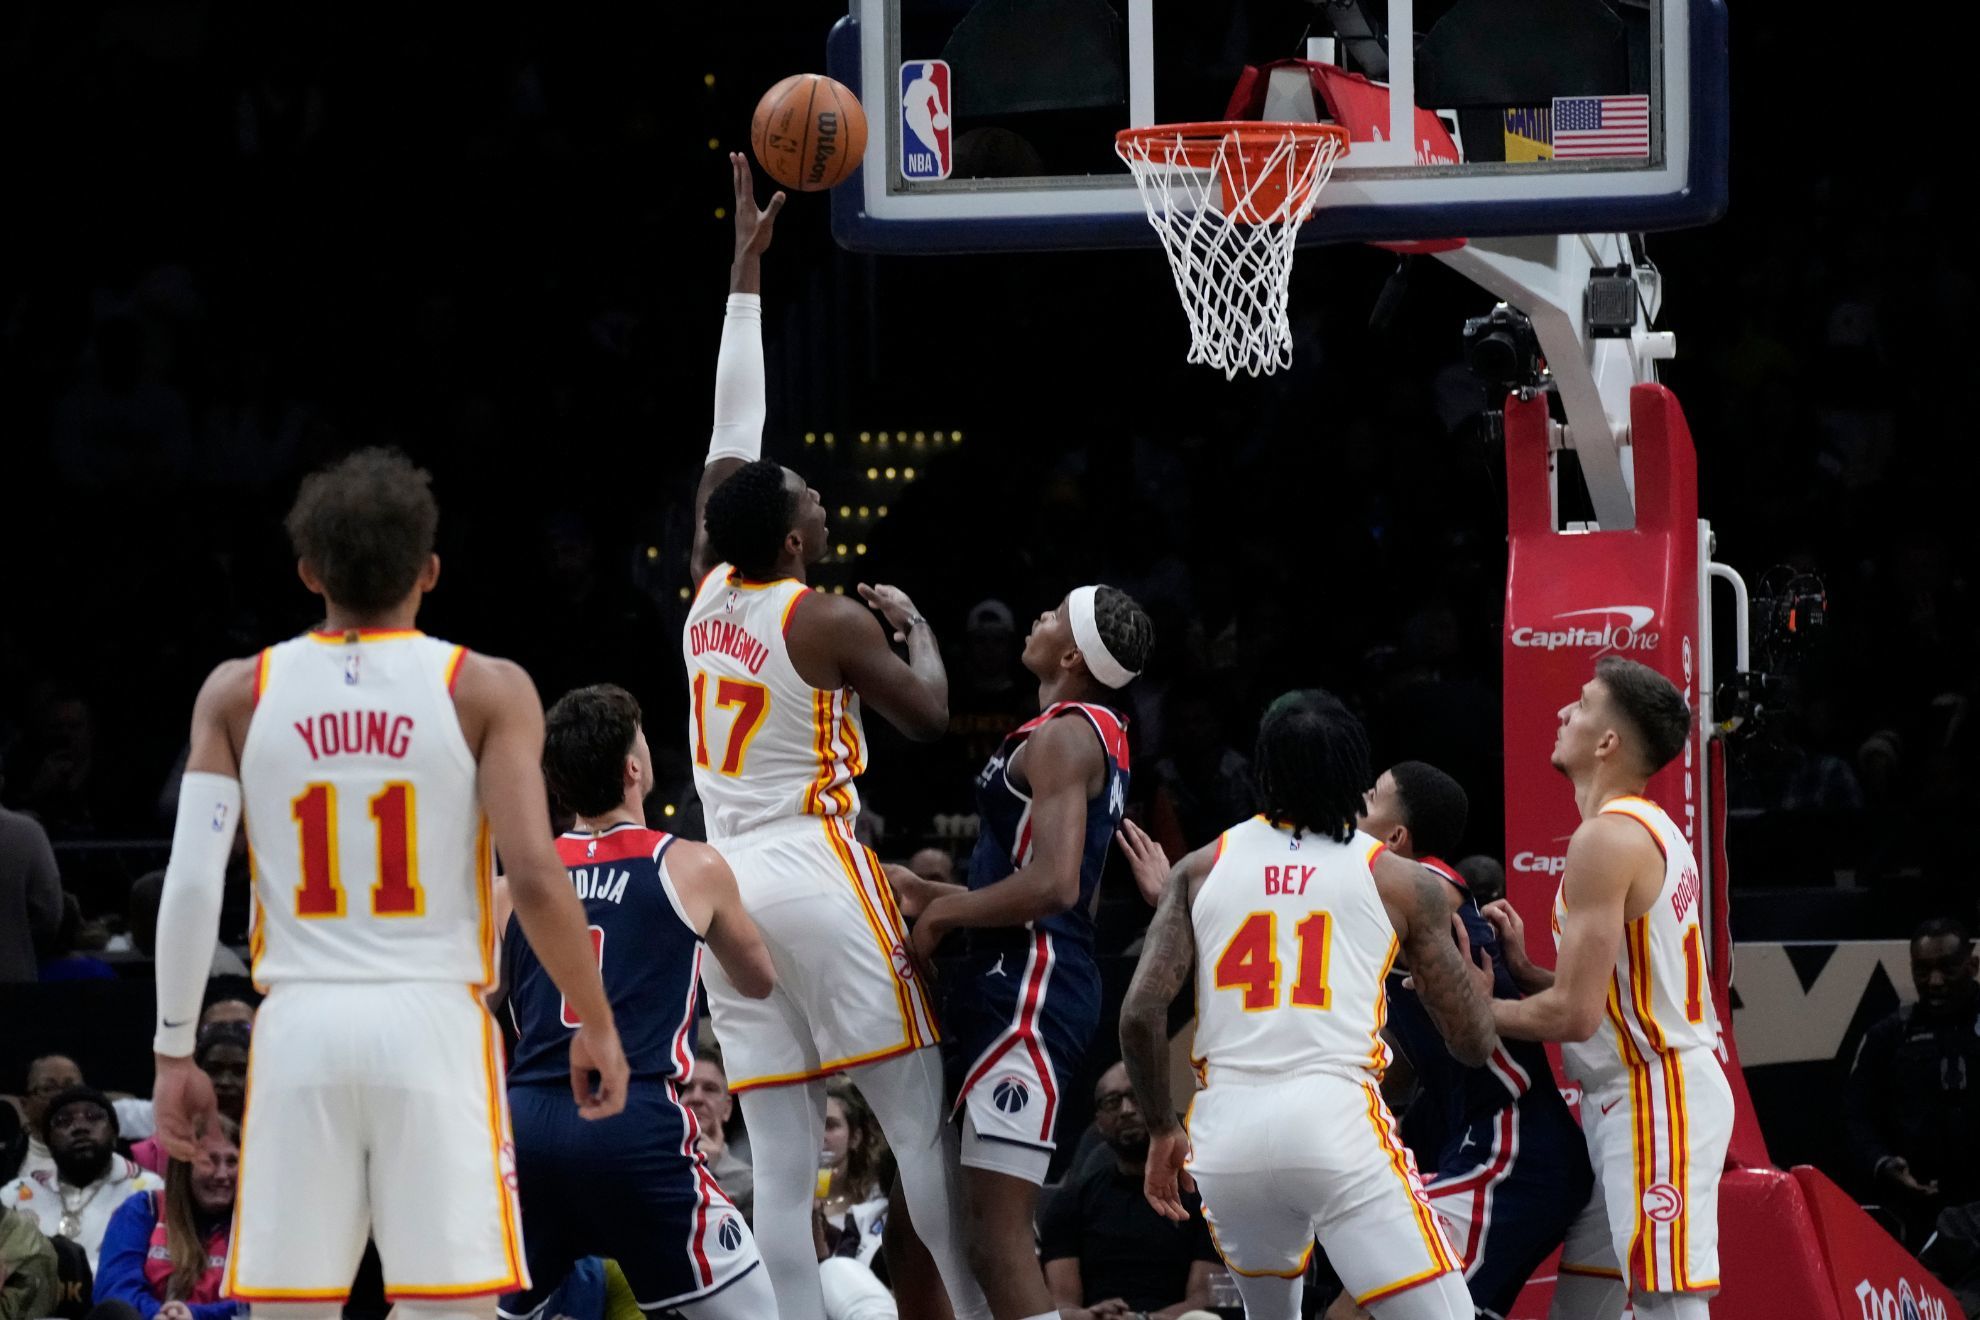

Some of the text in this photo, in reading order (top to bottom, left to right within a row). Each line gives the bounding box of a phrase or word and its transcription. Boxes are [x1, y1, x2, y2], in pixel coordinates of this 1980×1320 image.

[806, 112, 837, 183] Wilson
[908, 152, 933, 173] NBA
[689, 619, 769, 675] OKONGWU
[293, 710, 415, 761] YOUNG
[693, 667, 771, 778] 17
[291, 780, 426, 920] 11
[1512, 851, 1567, 877] Cap
[1264, 865, 1316, 895] BEY
[1214, 910, 1332, 1012] 41
